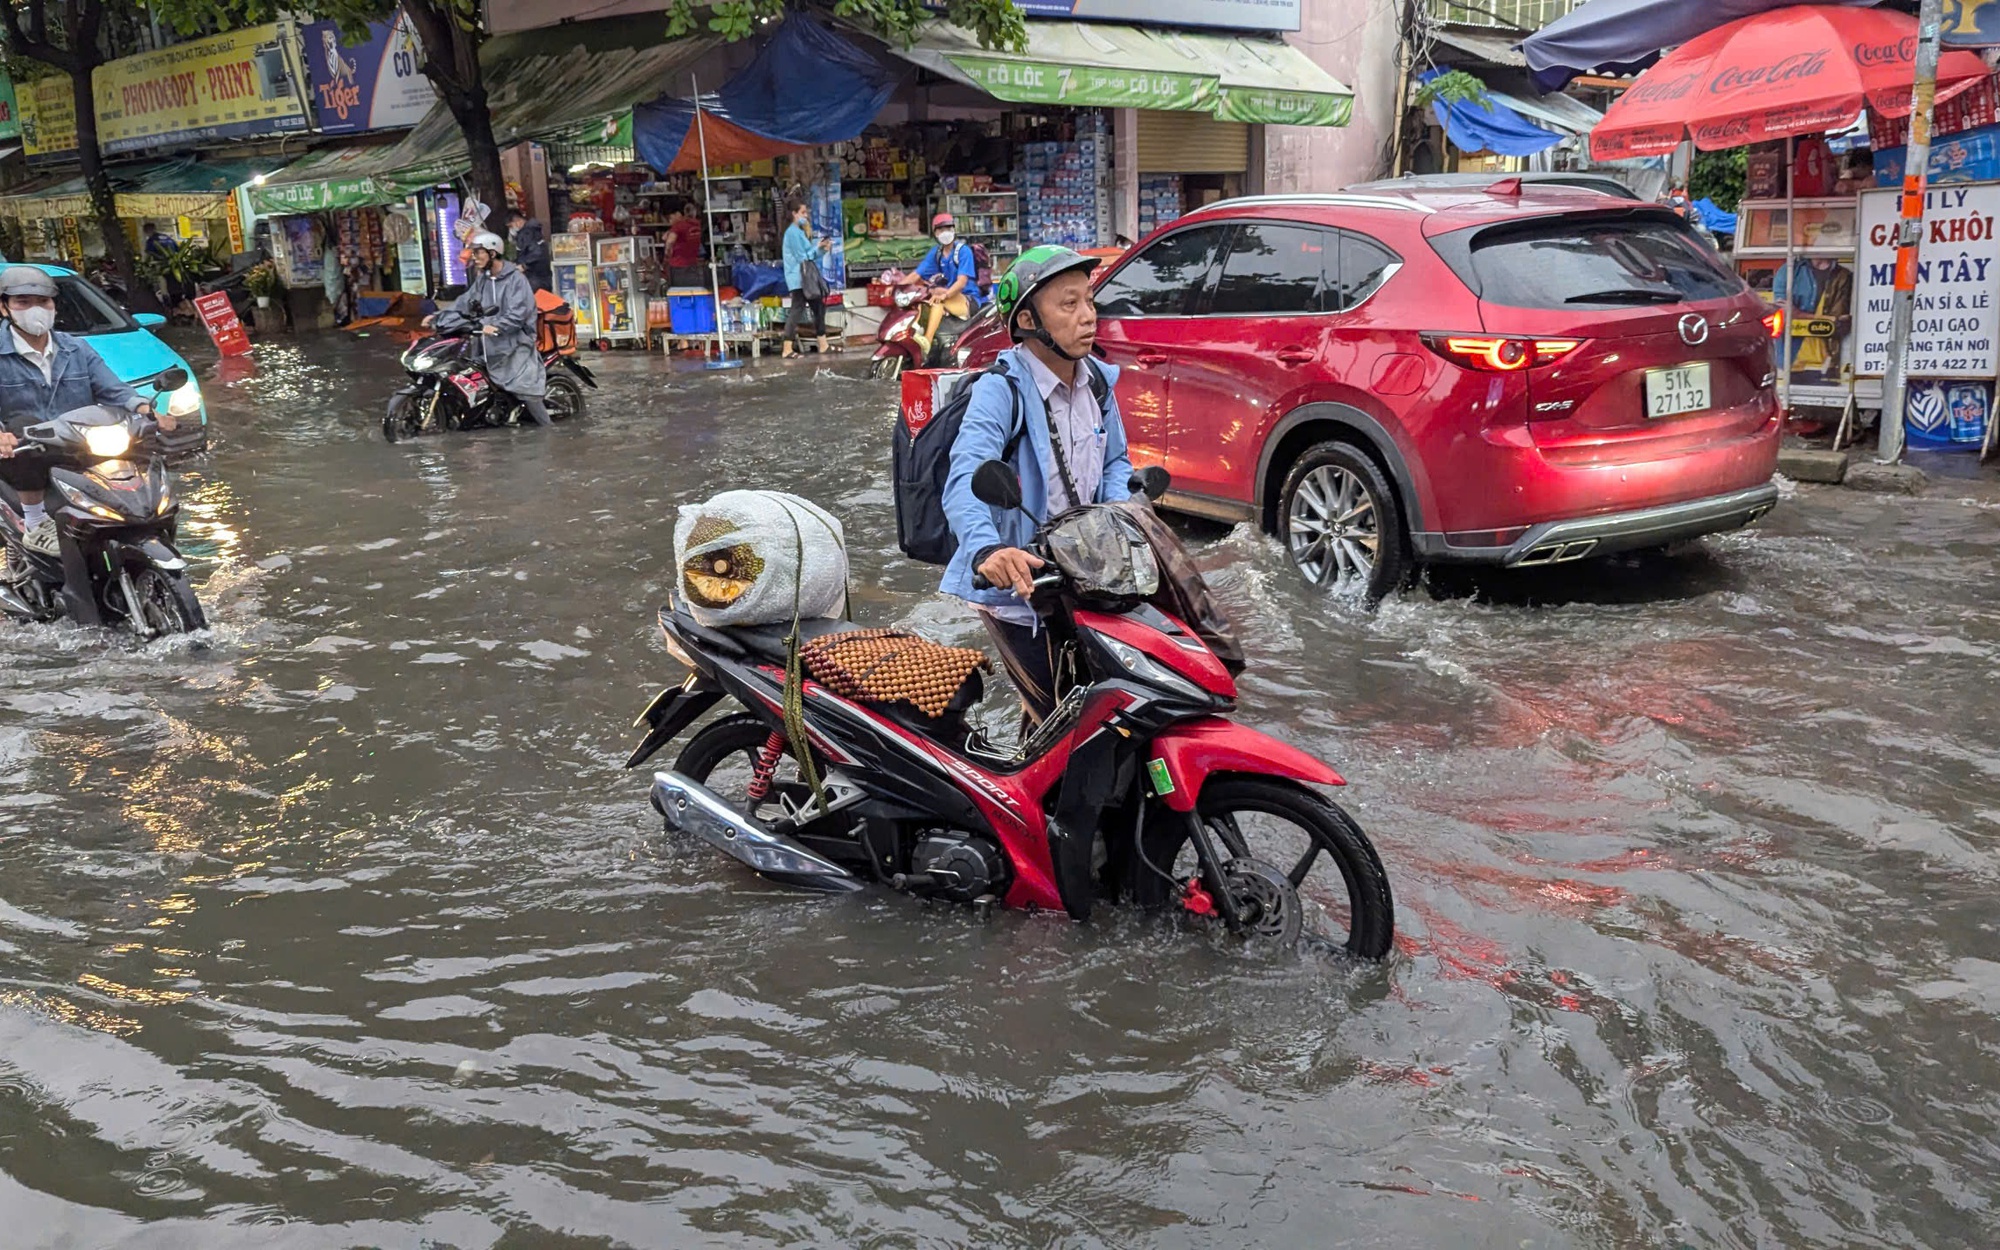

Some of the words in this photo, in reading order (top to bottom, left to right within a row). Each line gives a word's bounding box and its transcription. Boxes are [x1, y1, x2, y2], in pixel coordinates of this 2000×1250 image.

[1854, 36, 1916, 67] Coca-C
[988, 63, 1009, 85] CÔ
[1014, 66, 1045, 90] LỘC
[1130, 74, 1149, 93] CÔ
[1152, 76, 1179, 96] LỘC
[1709, 48, 1831, 94] Coca-Cola
[122, 71, 199, 117] PHOTOCOPY
[206, 60, 255, 102] PRINT
[319, 78, 360, 119] Tiger
[1941, 185, 1968, 209] LÝ
[1869, 221, 1923, 251] GẠ
[1929, 210, 1994, 244] KHÔI
[1938, 251, 1991, 283] TÂY
[1912, 293, 1934, 311] ÁN
[1955, 295, 1968, 309] &
[1972, 289, 1989, 309] LẺ
[1875, 318, 1893, 335] CÁ
[1947, 317, 1980, 336] GẠO
[1937, 337, 1963, 354] TẬN
[1967, 338, 1990, 351] NƠI
[1864, 361, 1885, 371] ĐT:
[1913, 359, 1938, 370] 374
[1942, 359, 1967, 370] 422
[1971, 358, 1988, 369] 71
[1665, 371, 1692, 391] 51K
[1655, 389, 1704, 413] 271.32
[951, 760, 1021, 807] SPORT
